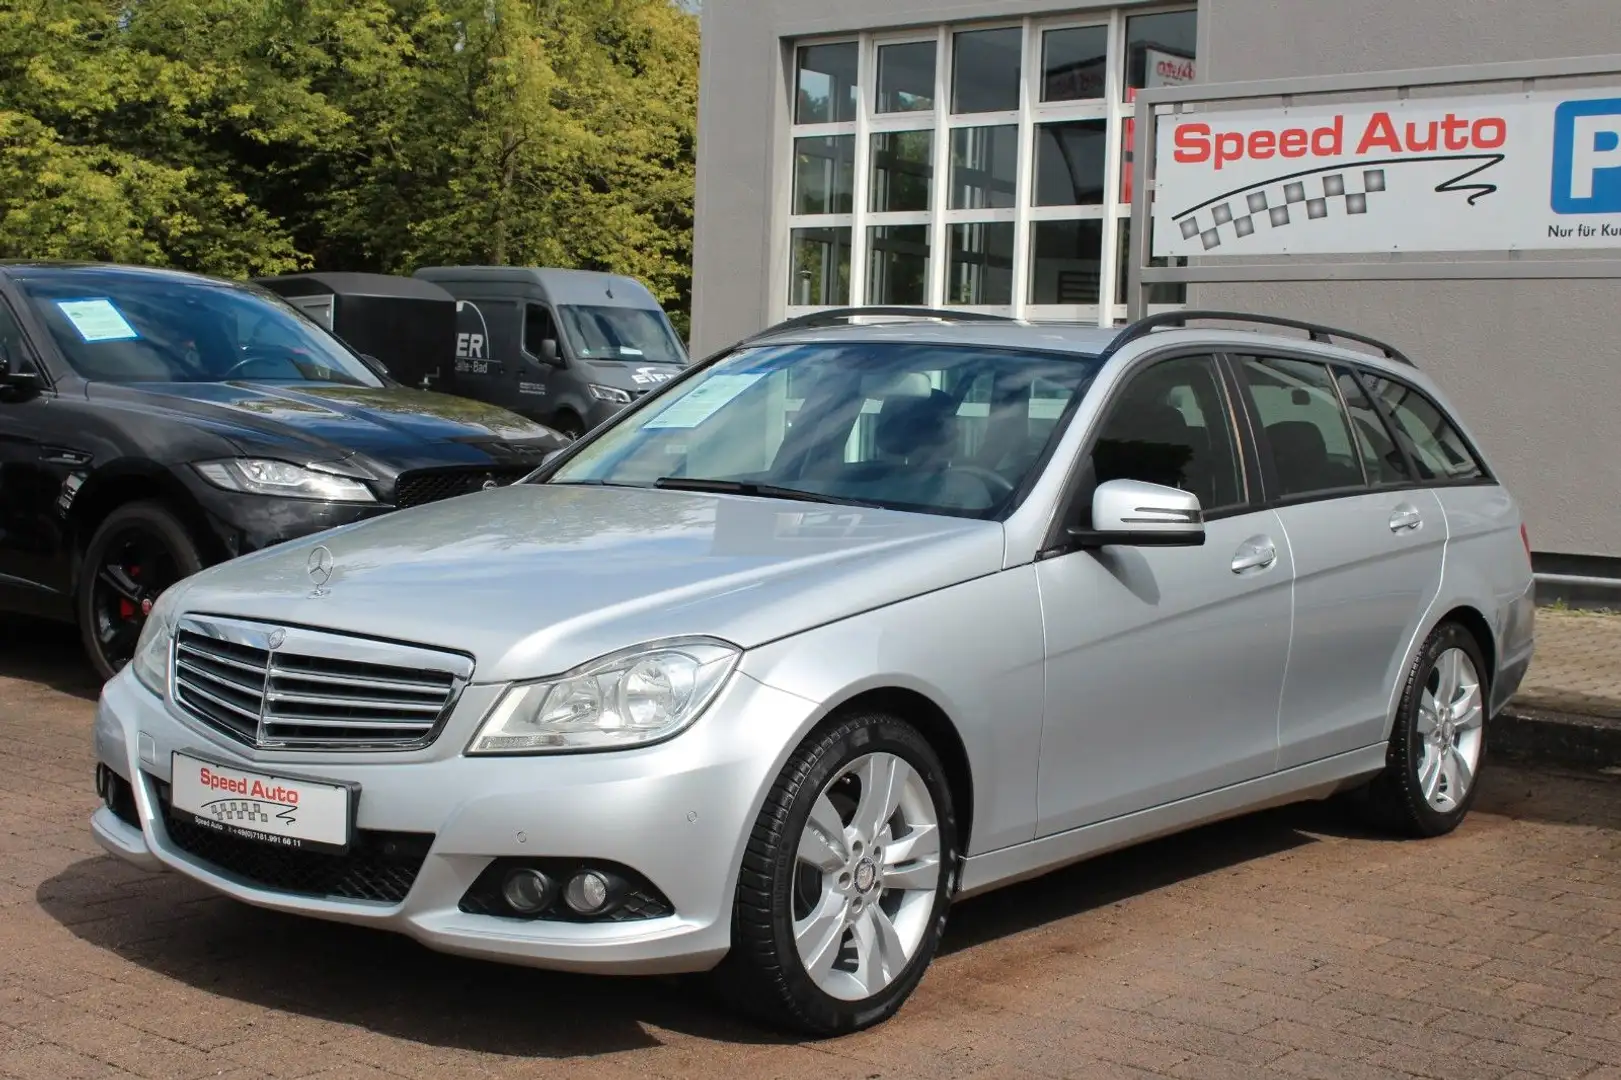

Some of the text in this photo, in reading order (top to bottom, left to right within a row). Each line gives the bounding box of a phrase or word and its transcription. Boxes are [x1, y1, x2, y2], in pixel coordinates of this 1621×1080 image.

[1174, 112, 1507, 170] Speed Auto
[1570, 114, 1621, 199] P
[1547, 223, 1621, 238] Nur für Ku
[200, 767, 298, 803] Speed Auto
[195, 815, 210, 827] Speed
[211, 822, 223, 830] Auto
